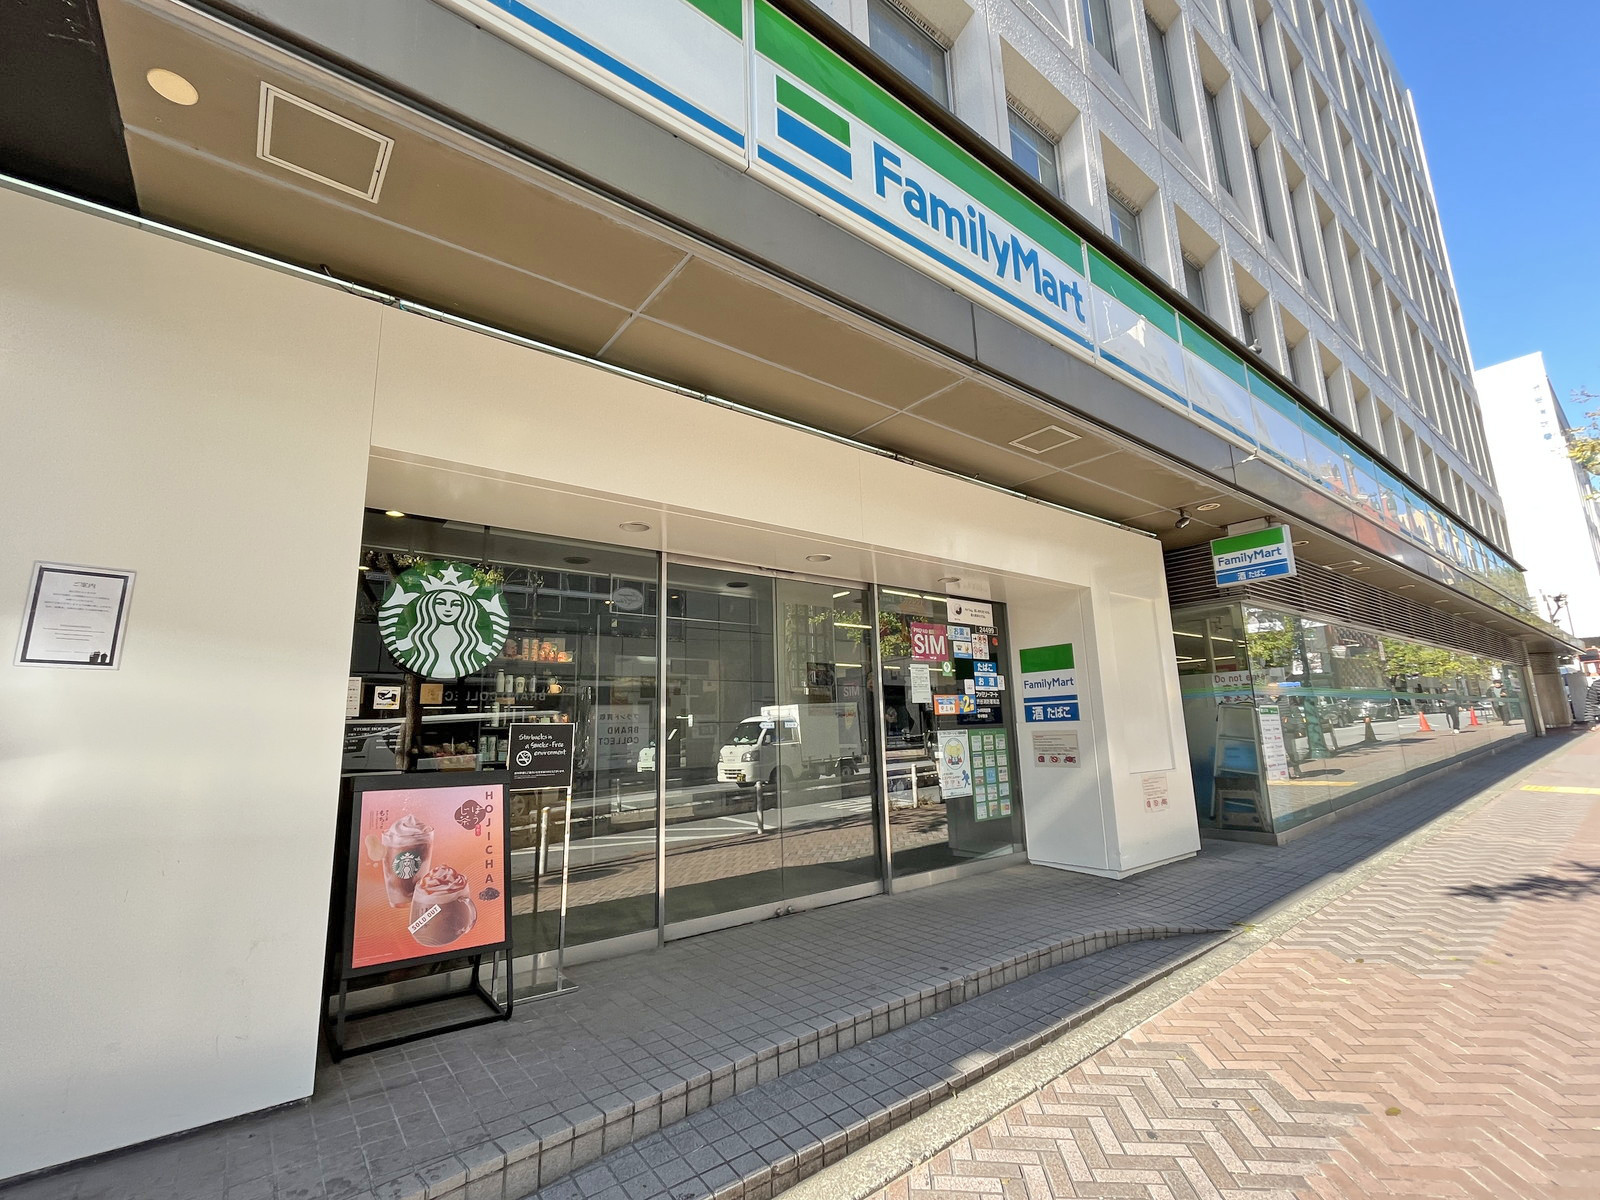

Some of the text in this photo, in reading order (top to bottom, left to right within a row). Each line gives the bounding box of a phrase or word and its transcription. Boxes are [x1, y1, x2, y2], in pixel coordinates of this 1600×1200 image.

[872, 140, 1087, 324] FamilyMart
[1217, 546, 1282, 567] FamilyMart
[1237, 569, 1267, 581] 酒 たばこ
[913, 633, 946, 655] SIM
[976, 662, 994, 672] たばこ
[1024, 677, 1075, 690] FamilyMart
[1214, 674, 1226, 684] Do
[1228, 673, 1243, 683] not
[843, 685, 860, 697] SIM
[1032, 705, 1072, 720] 酒 たばこ
[518, 733, 547, 741] Starbucks
[533, 748, 566, 756] environment
[485, 790, 494, 884] HOJICHA
[411, 906, 439, 931] SOLD OUT
